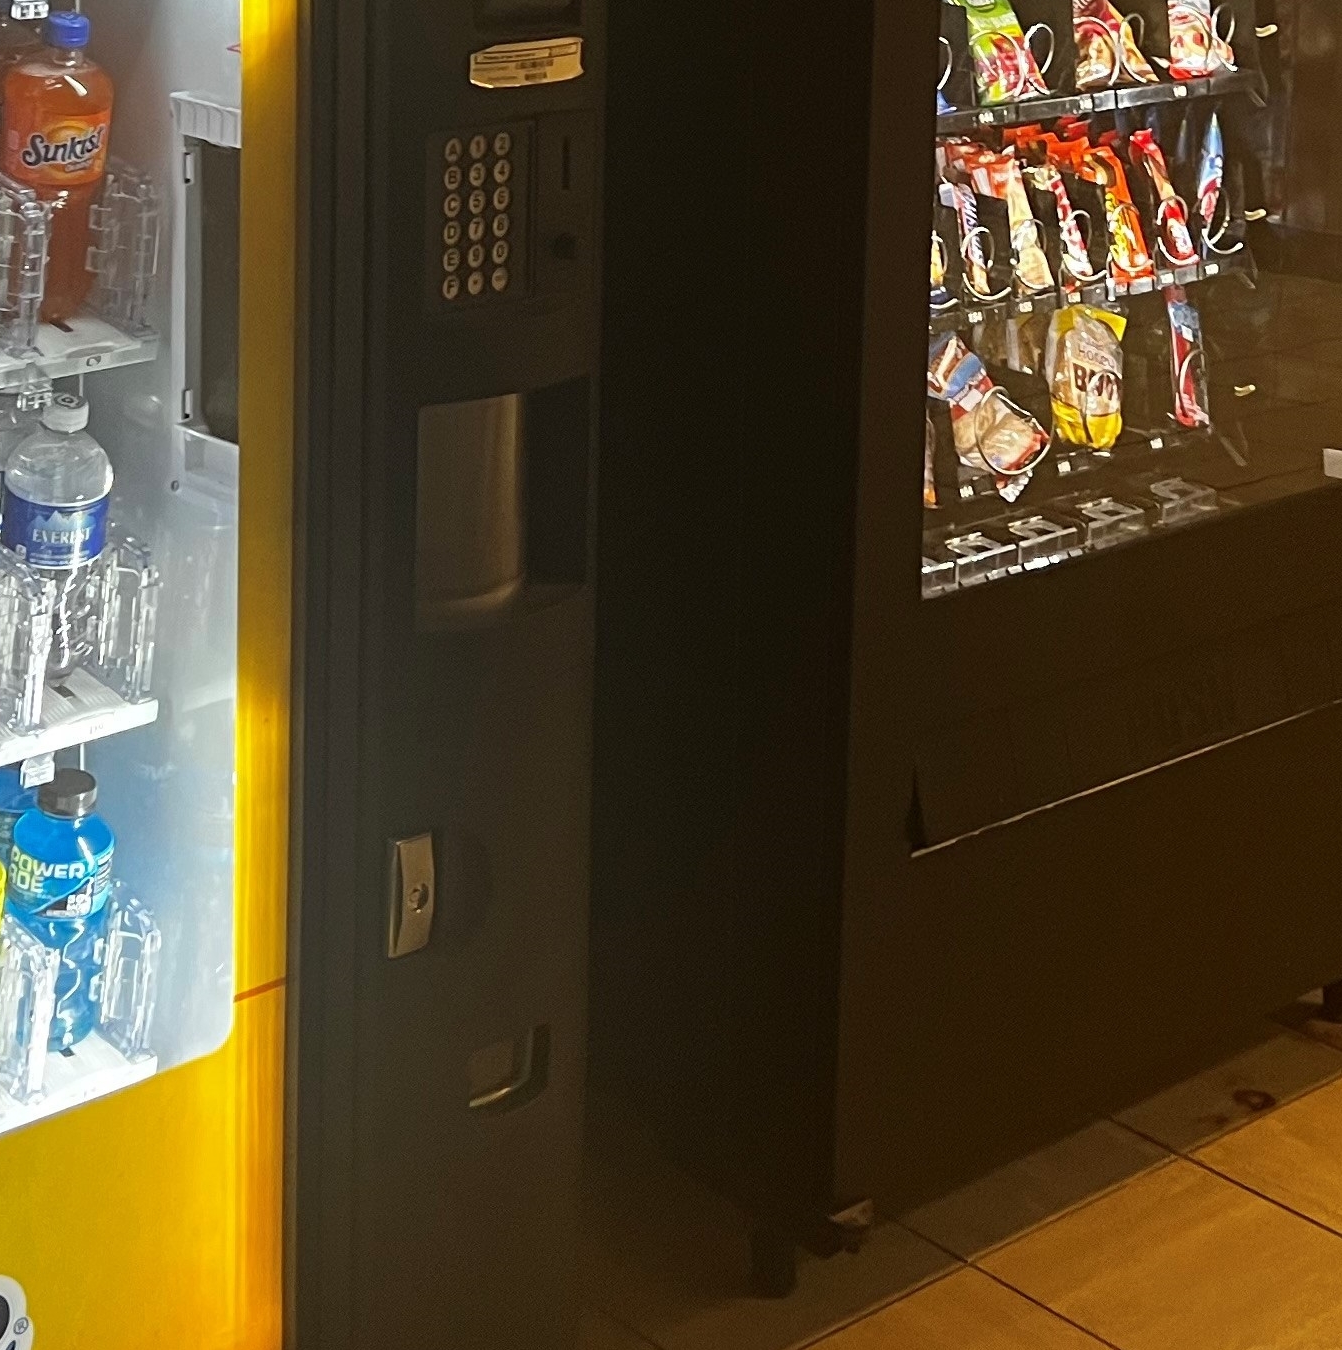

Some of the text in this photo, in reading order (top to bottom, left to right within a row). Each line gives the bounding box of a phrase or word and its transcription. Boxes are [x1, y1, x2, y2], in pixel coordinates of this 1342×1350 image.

[22, 124, 106, 169] Sunkist
[9, 863, 45, 894] ADE
[11, 845, 86, 879] POWER
